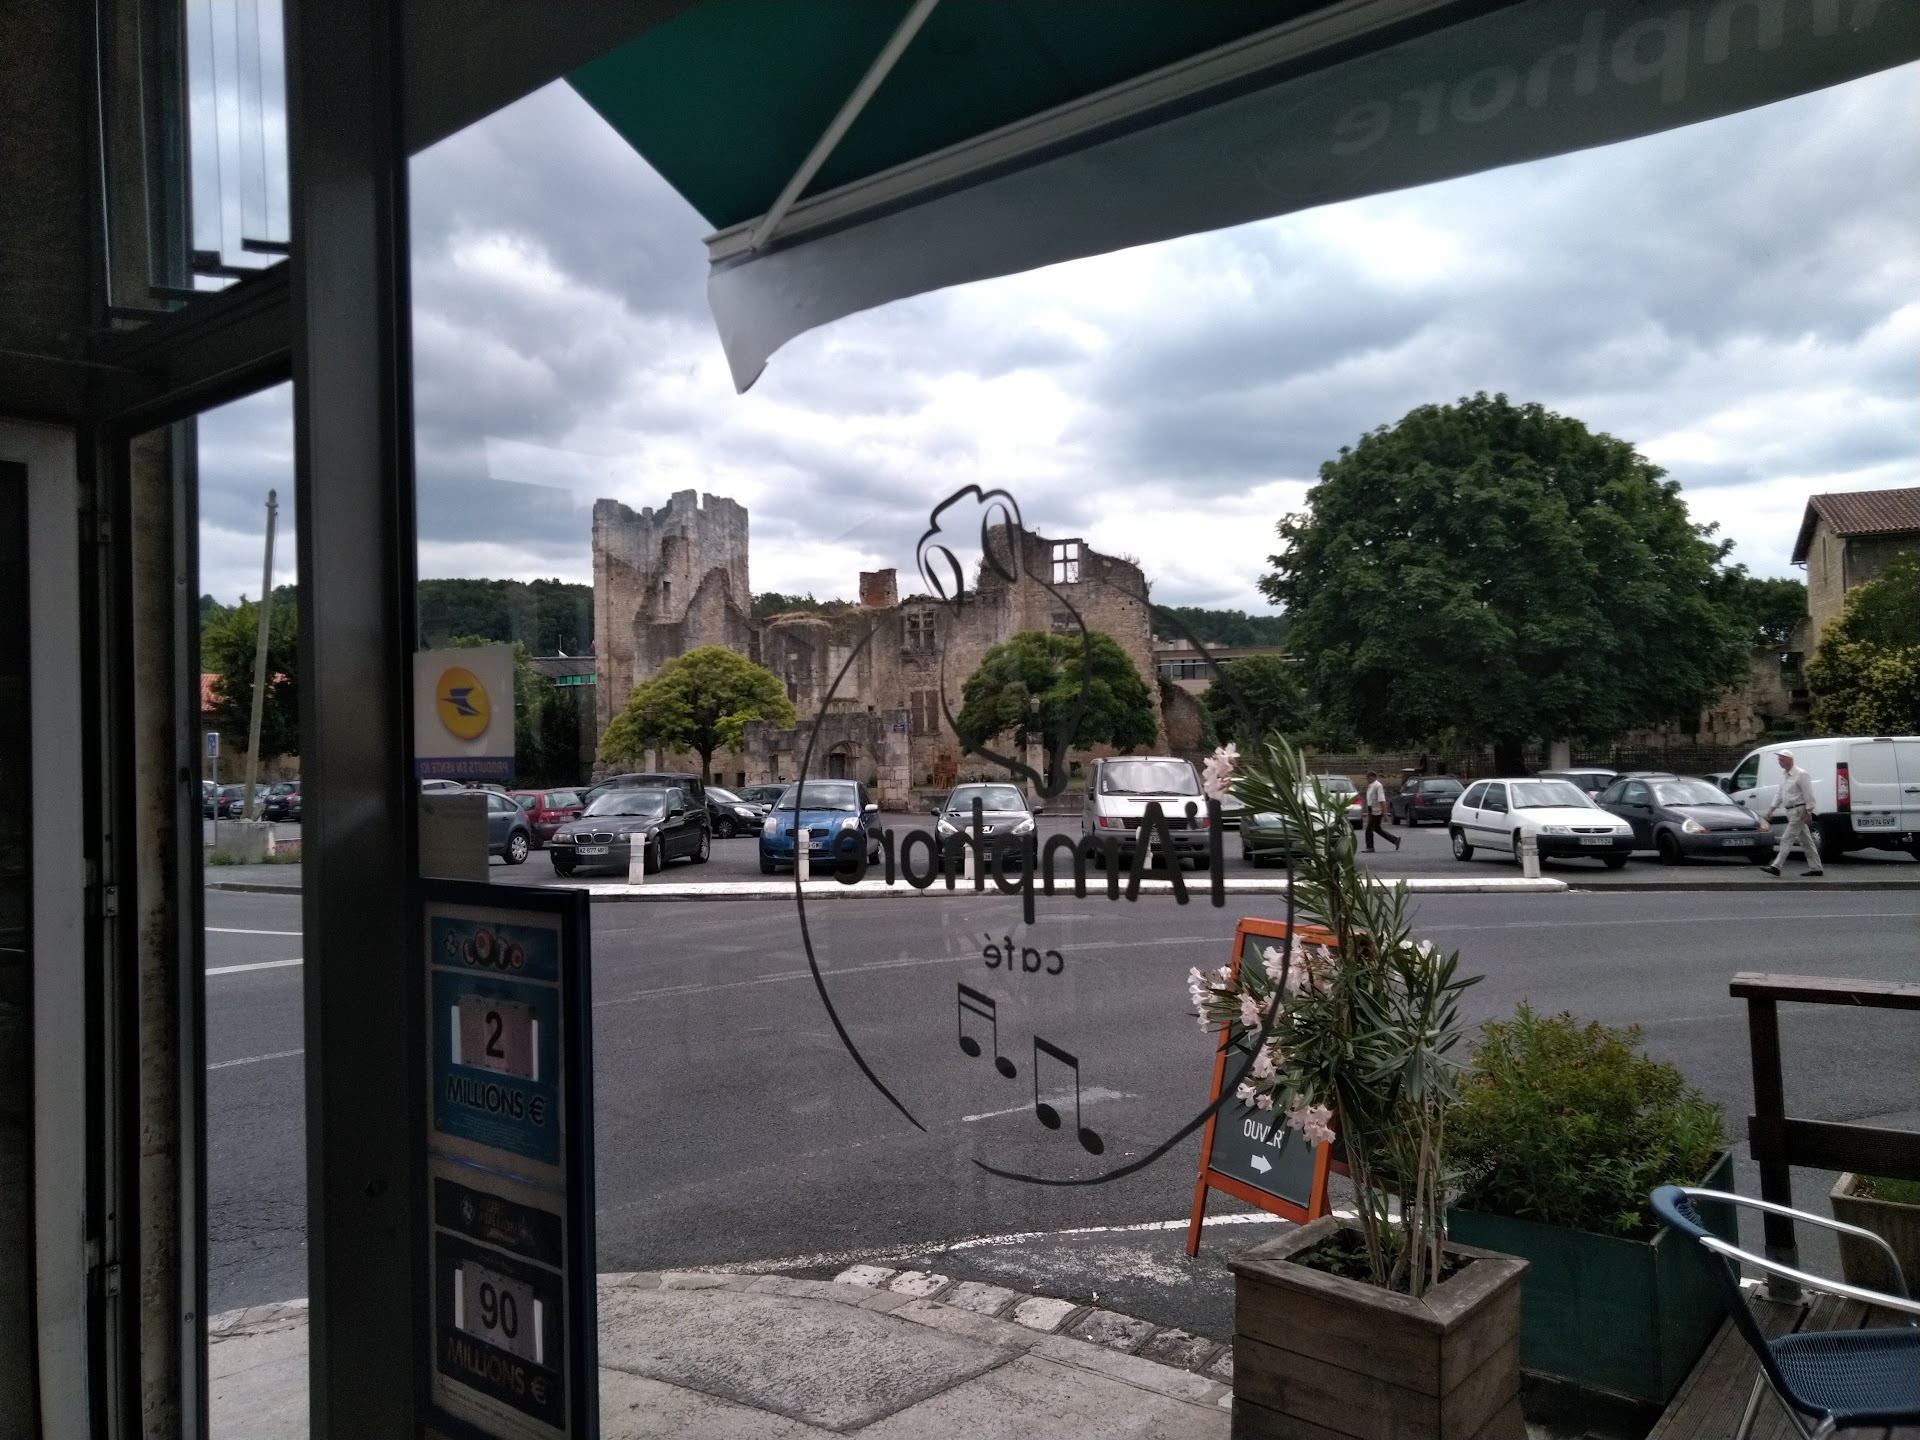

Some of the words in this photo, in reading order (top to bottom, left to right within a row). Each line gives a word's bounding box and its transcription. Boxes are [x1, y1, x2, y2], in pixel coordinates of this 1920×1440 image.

[485, 1010, 505, 1060] 2
[446, 1075, 525, 1120] MILLIONS
[528, 1096, 547, 1126] €
[1243, 1118, 1285, 1149] OUVR
[479, 1282, 518, 1339] 90
[447, 1336, 526, 1396] MILLIONS
